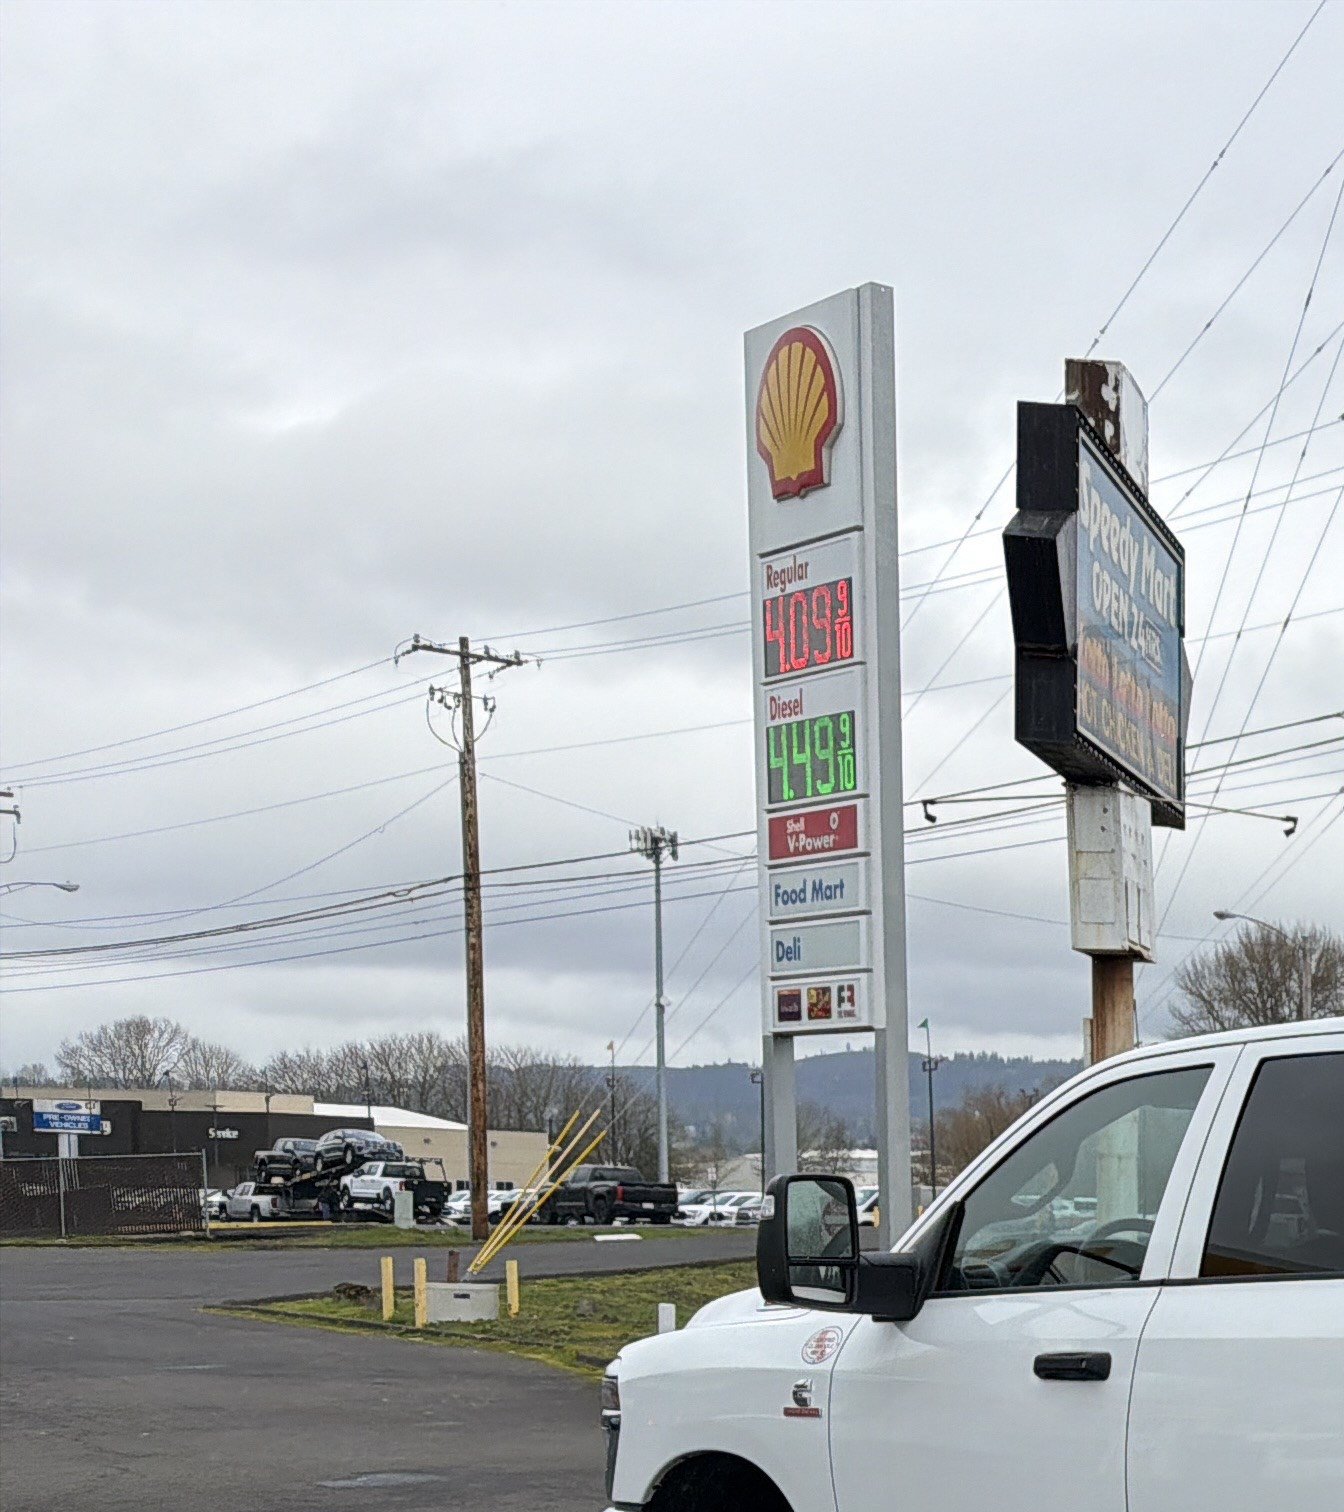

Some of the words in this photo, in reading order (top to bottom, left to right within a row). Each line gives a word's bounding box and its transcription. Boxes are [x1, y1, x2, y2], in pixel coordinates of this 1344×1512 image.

[1080, 460, 1139, 597] Speedy
[1141, 534, 1177, 629] Mart
[766, 555, 810, 592] Regular
[1092, 560, 1131, 641] OPEN
[1131, 602, 1146, 658] 24
[765, 585, 832, 674] 4.09
[769, 688, 804, 721] Diesel
[769, 716, 835, 801] 4.49
[786, 816, 805, 834] Shell
[774, 878, 808, 907] Food
[811, 878, 845, 903] Mart
[775, 936, 802, 962] Deli
